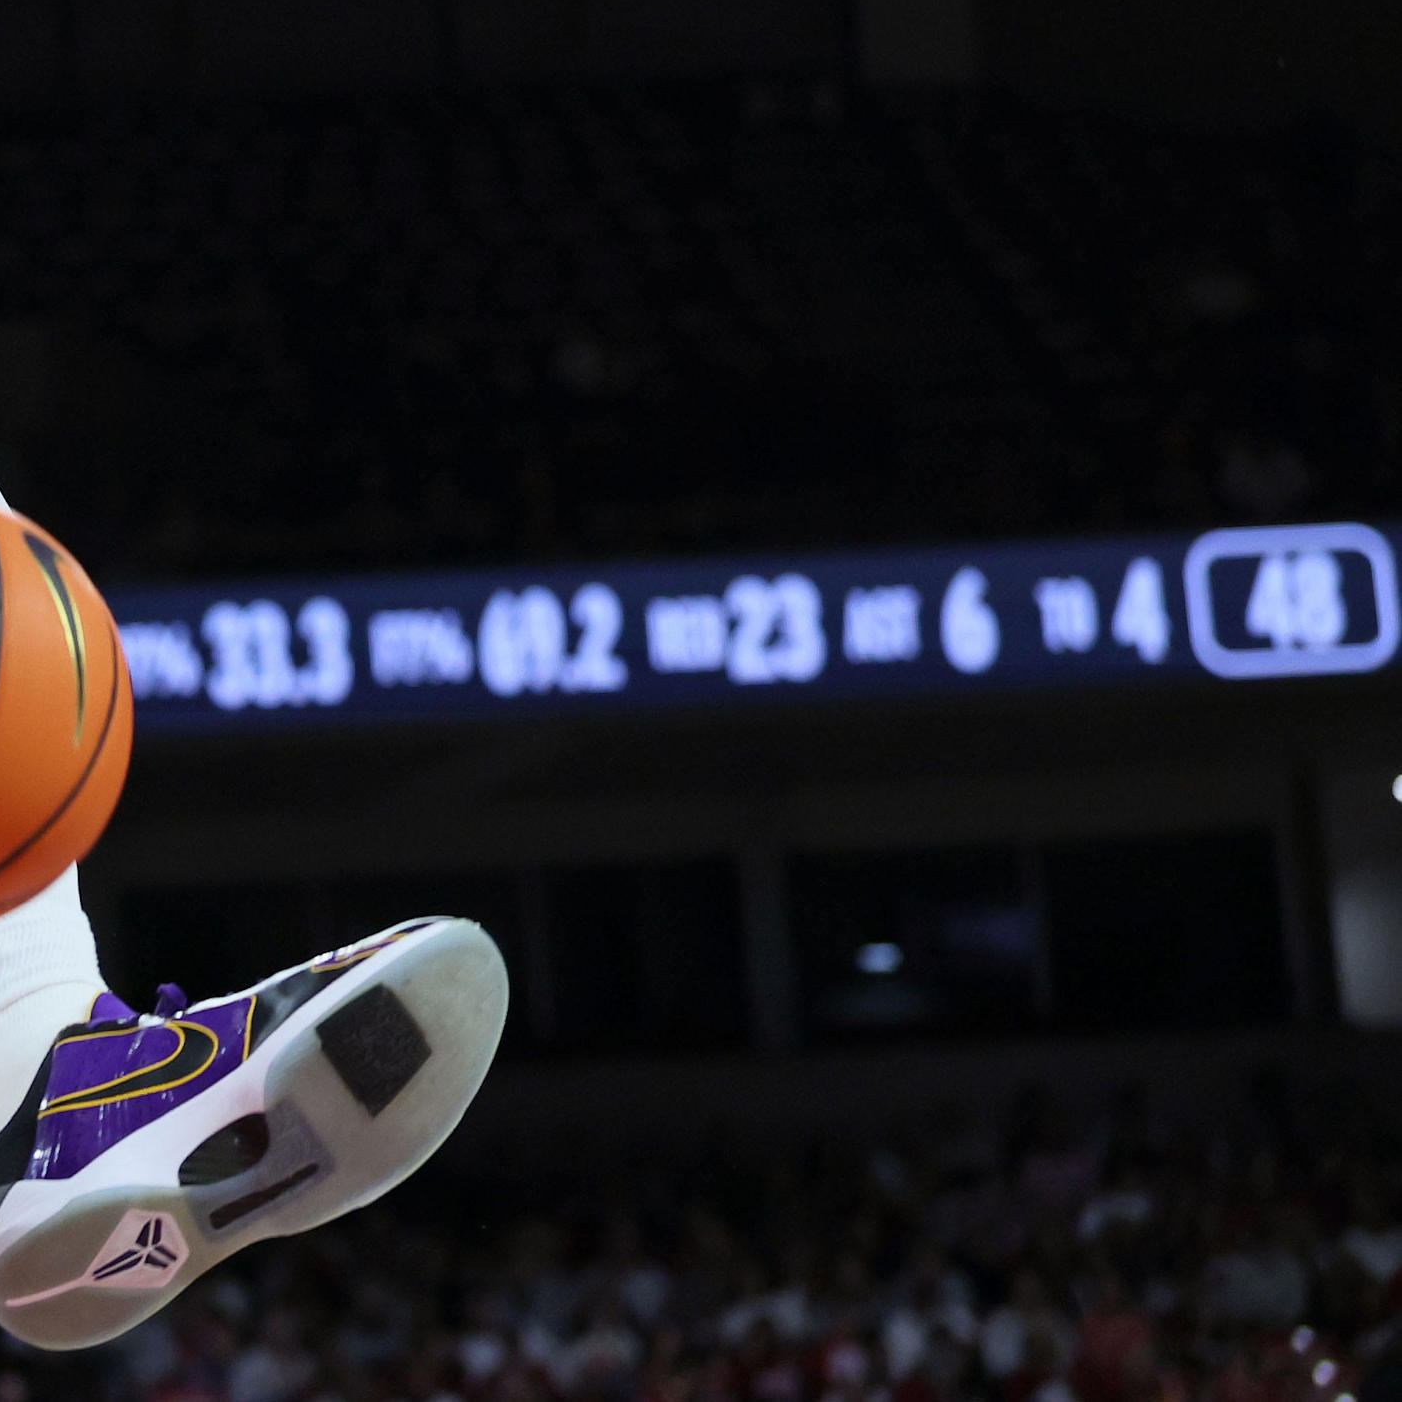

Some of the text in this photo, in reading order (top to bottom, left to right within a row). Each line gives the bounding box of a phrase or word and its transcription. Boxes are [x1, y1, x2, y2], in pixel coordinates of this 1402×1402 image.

[724, 574, 826, 685] 23
[940, 565, 999, 674] 6
[1112, 556, 1170, 663] 4
